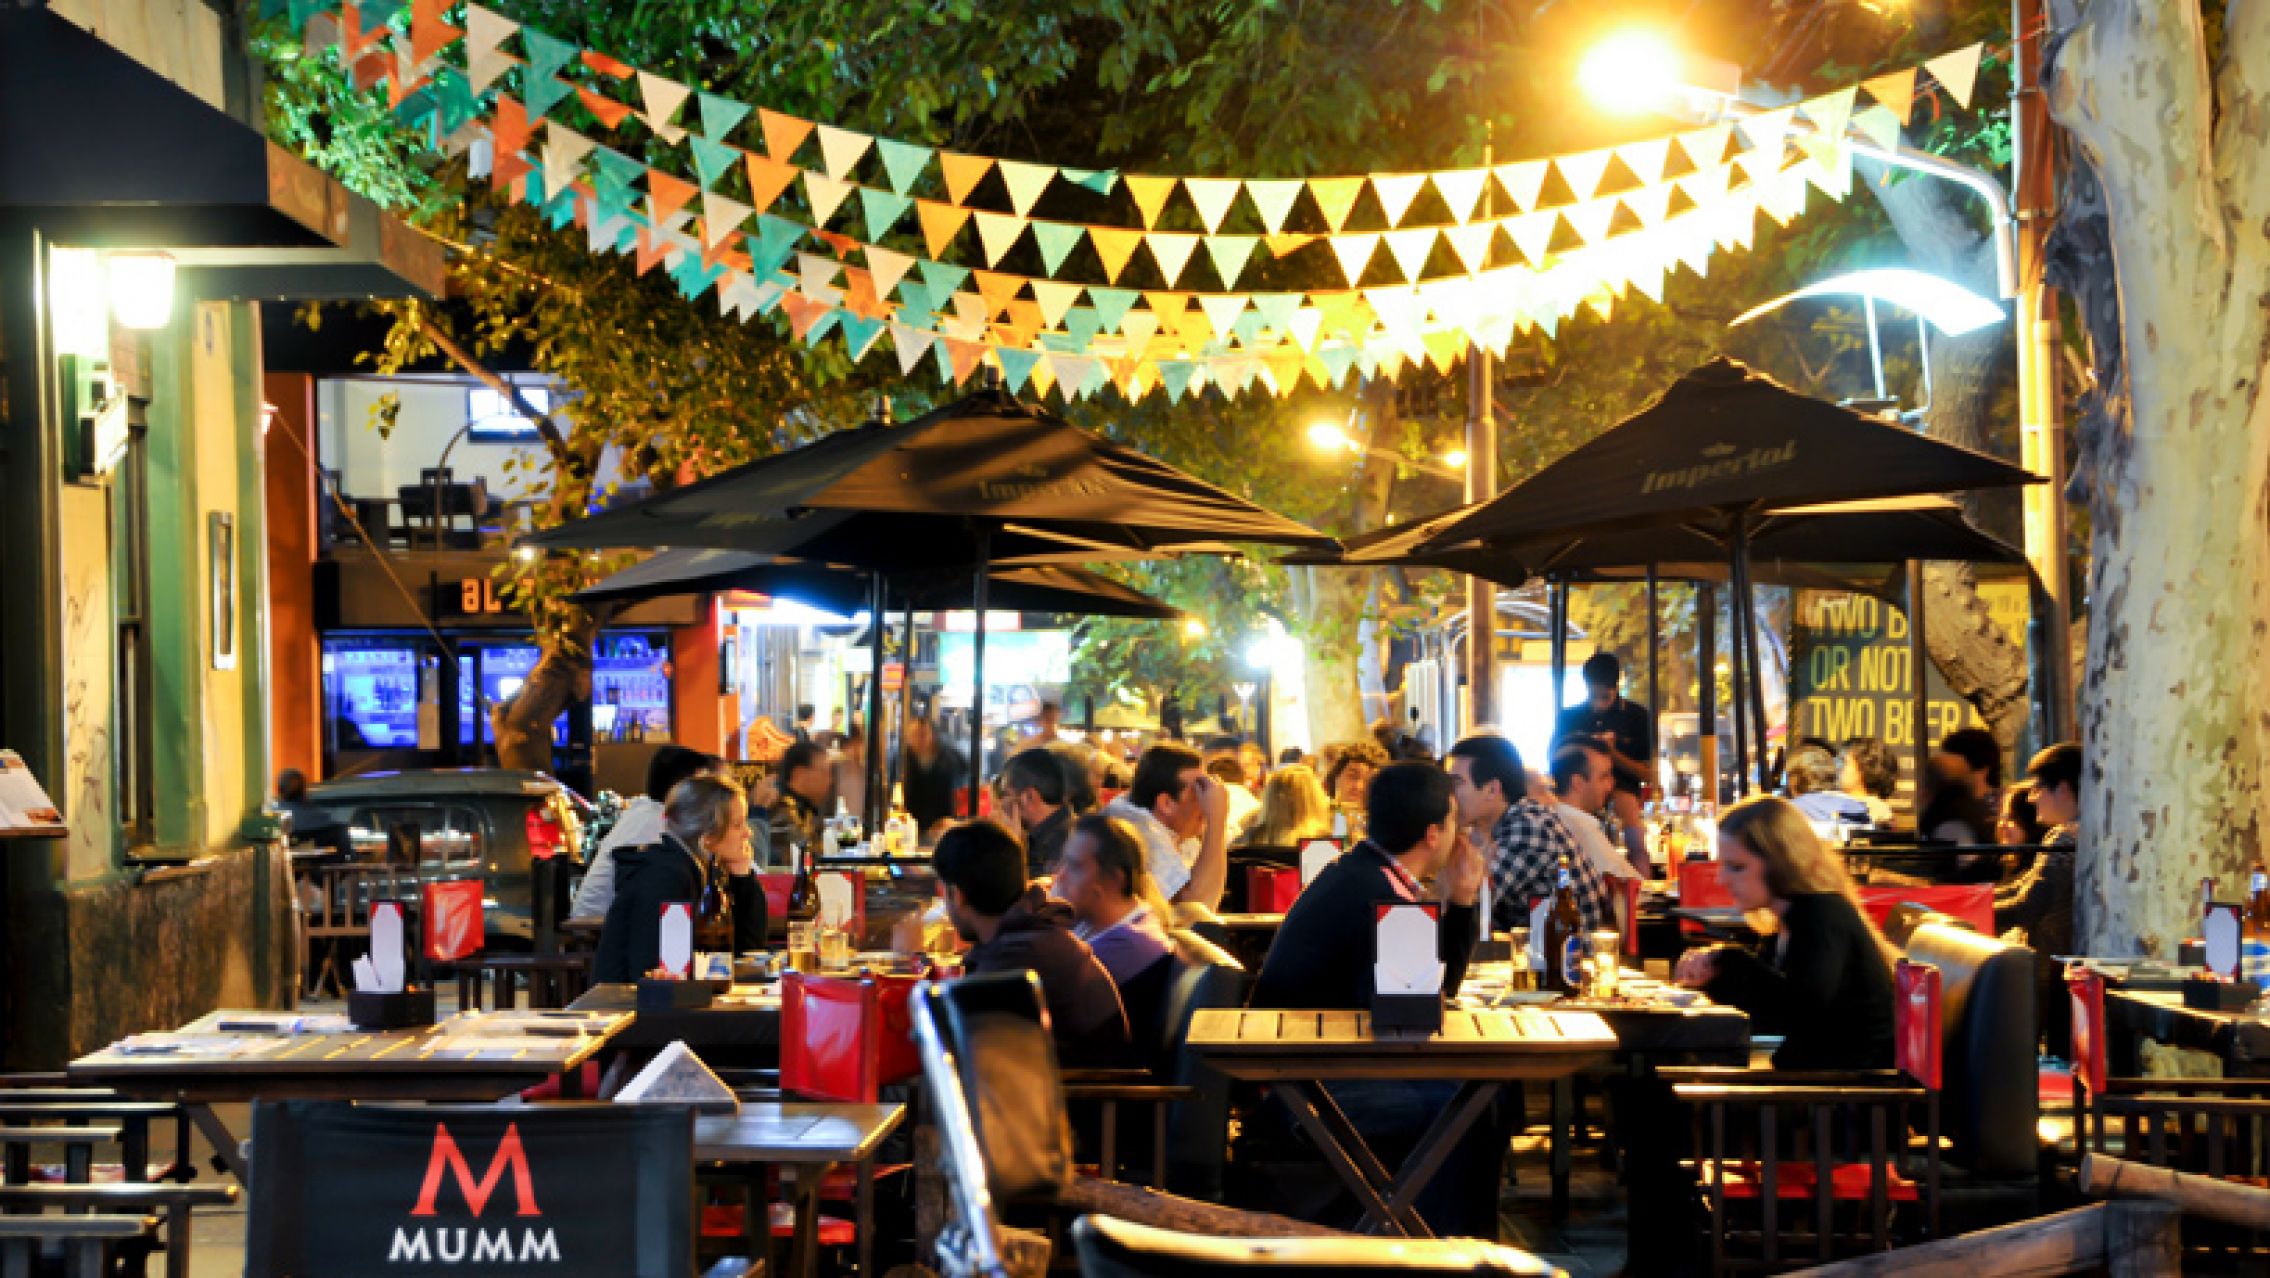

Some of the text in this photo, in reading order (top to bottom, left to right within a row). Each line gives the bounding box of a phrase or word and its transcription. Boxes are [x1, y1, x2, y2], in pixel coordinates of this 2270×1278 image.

[976, 477, 1112, 502] Imperal
[1641, 439, 1797, 494] Imperial
[1815, 593, 1878, 639] TWO
[1811, 644, 1912, 693] OR NOT
[1807, 696, 1876, 743] TWO
[409, 1121, 544, 1219] M
[387, 1225, 563, 1264] MUMM
